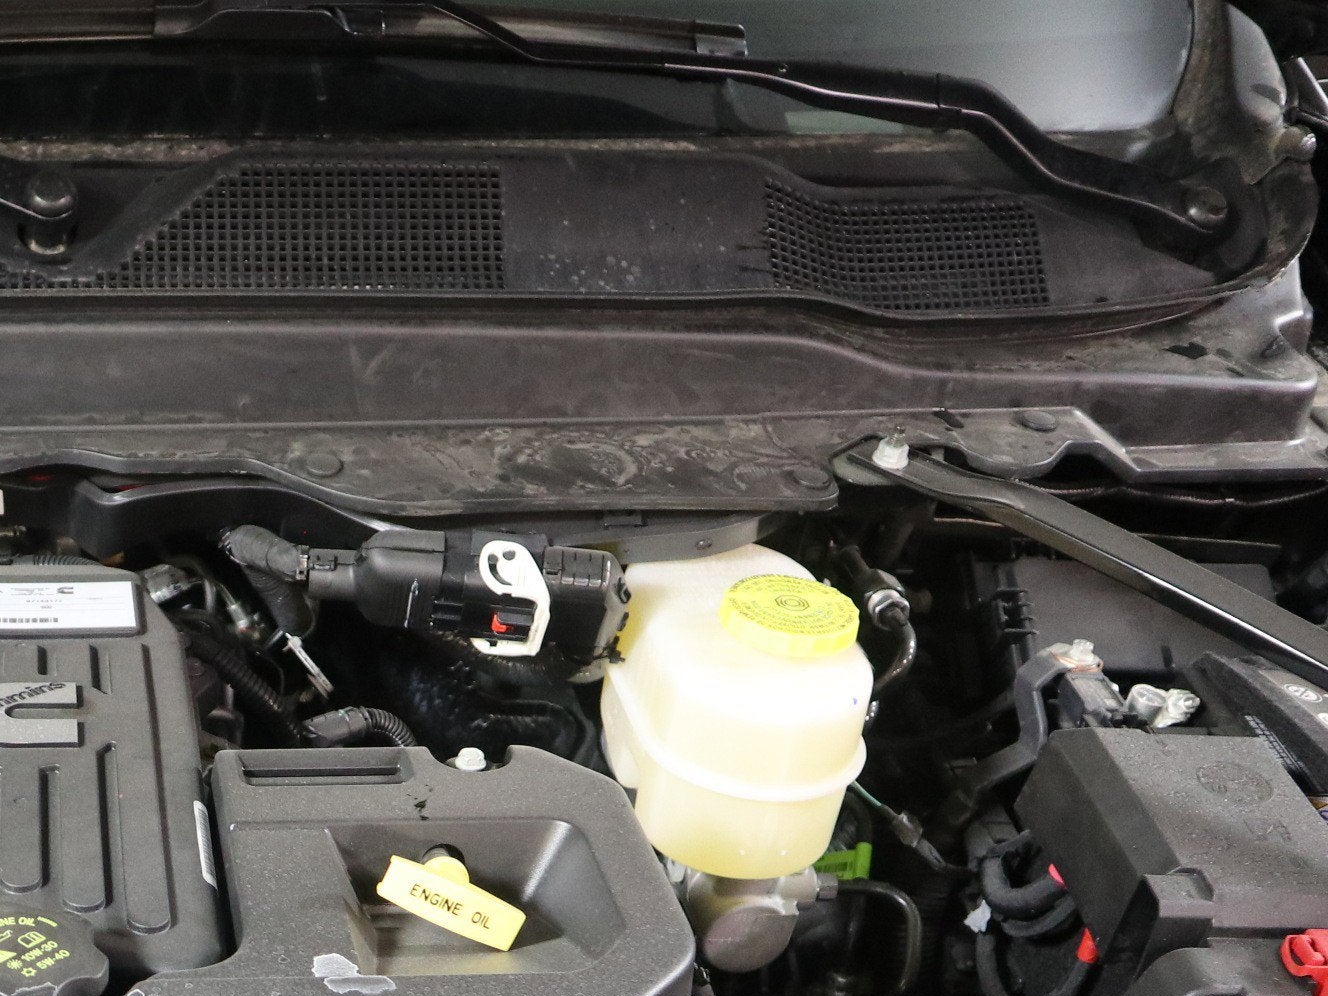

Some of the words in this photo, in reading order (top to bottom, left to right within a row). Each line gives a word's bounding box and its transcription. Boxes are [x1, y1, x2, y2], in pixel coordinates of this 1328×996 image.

[409, 883, 464, 916] ENGINE
[471, 911, 491, 930] OIL
[18, 916, 36, 927] OIL
[21, 940, 59, 962] 10W-30
[36, 949, 71, 970] 5W-40
